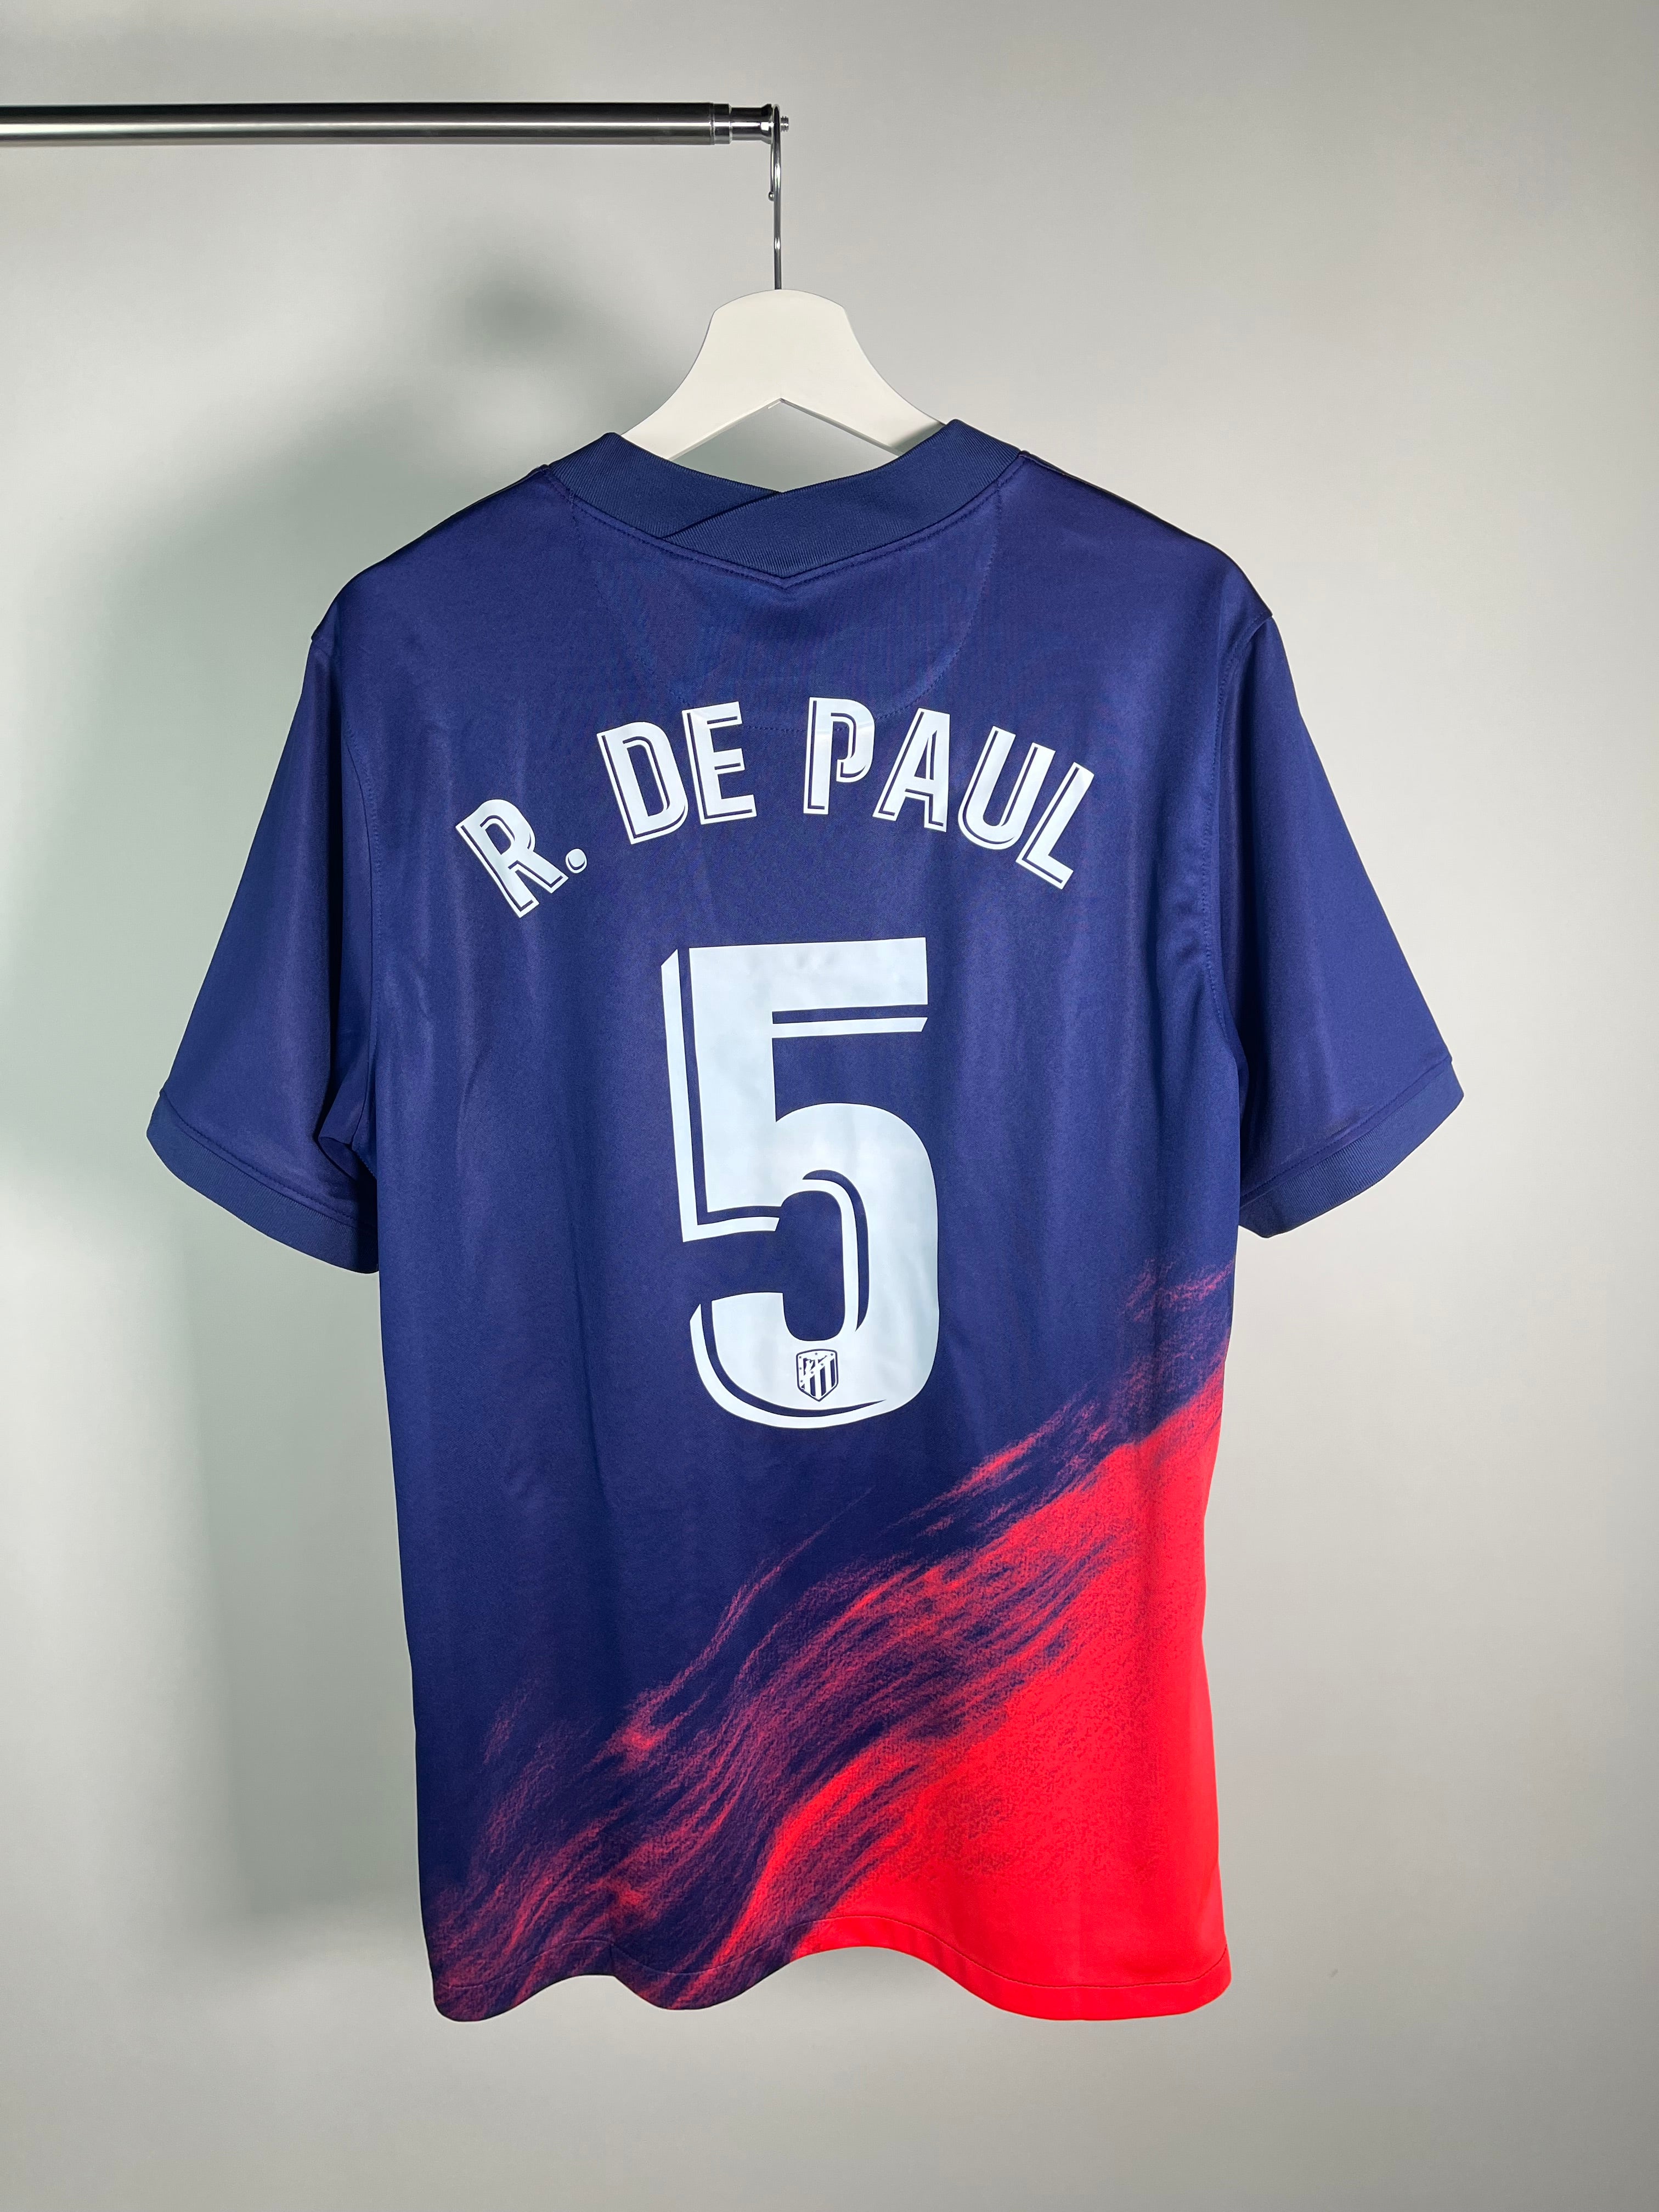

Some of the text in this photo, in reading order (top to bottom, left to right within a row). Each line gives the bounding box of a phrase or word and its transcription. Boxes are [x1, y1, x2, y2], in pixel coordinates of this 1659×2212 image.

[456, 697, 1095, 918] R. DE PAUL
[661, 936, 940, 1430] 5
